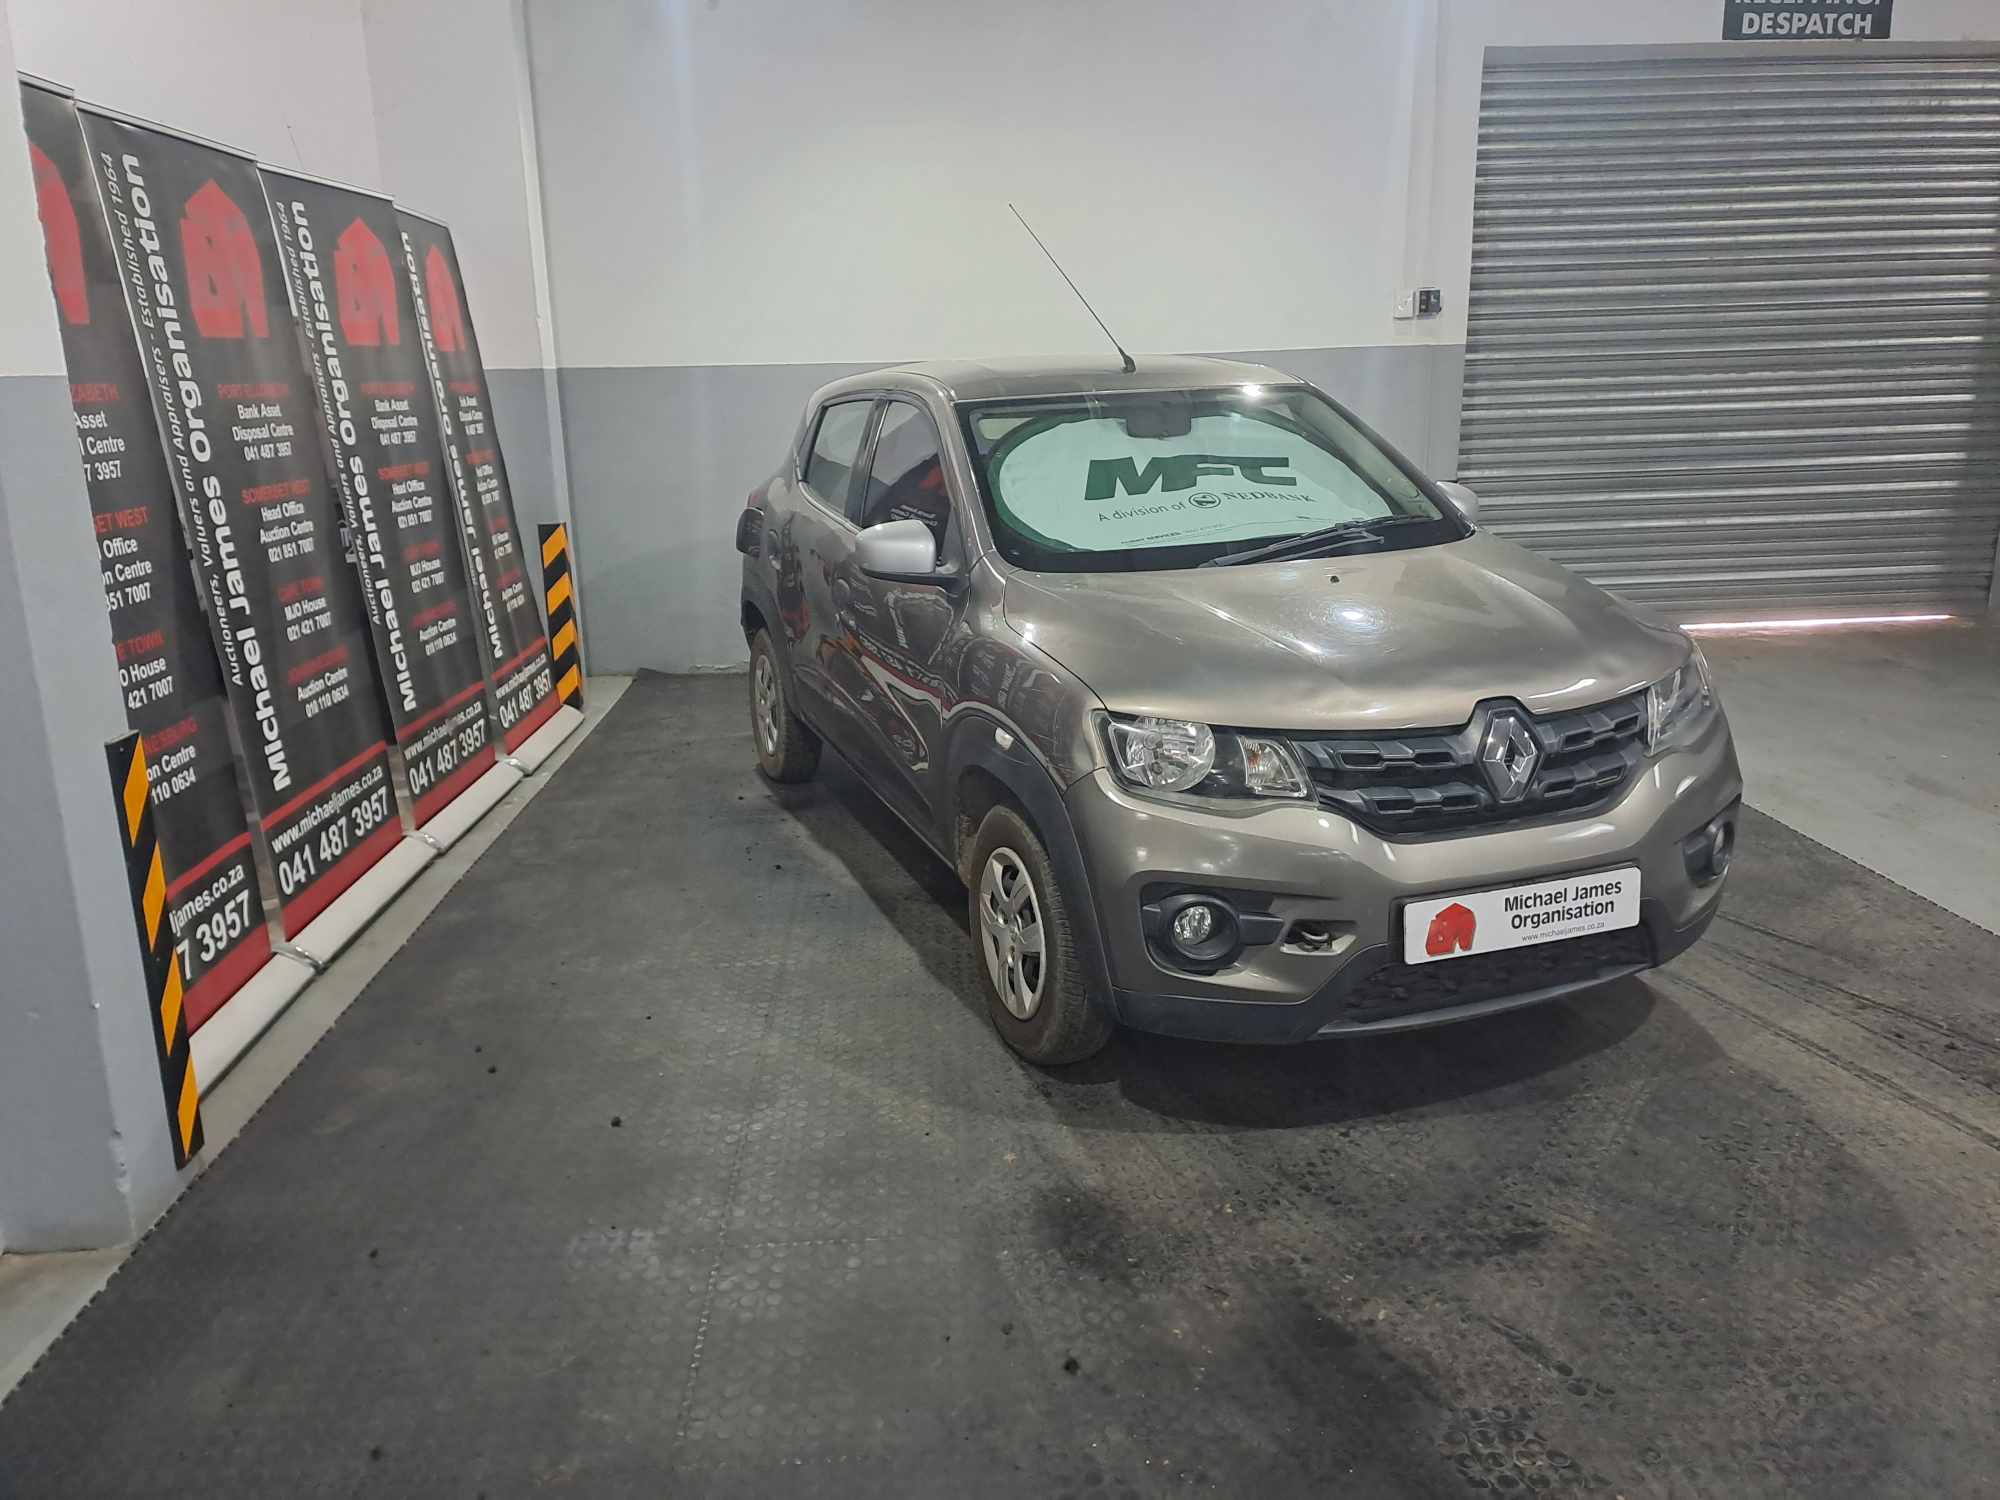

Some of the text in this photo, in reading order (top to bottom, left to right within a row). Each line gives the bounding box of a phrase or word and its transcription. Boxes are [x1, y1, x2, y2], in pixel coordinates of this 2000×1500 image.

[1742, 12, 1872, 34] DESPATCH
[101, 152, 123, 204] 1964
[114, 210, 154, 329] Established
[292, 202, 356, 446] Organisation
[152, 346, 186, 450] Appraisers
[237, 404, 260, 420] Bank
[86, 436, 126, 456] Centre
[232, 424, 270, 442] Disposal
[244, 445, 260, 461] 041
[260, 443, 276, 459] 487
[331, 438, 344, 468] and
[95, 460, 122, 481] 3957
[122, 154, 291, 792] Michael James Organisation
[176, 454, 195, 492] and
[1084, 454, 1297, 501] MFC
[350, 455, 386, 570] James
[1098, 490, 1317, 522] A division of NEDBANK
[189, 497, 213, 567] Valuers
[260, 525, 290, 544] Auction
[102, 537, 139, 559] Office
[268, 546, 283, 563] 021
[114, 559, 152, 584] Centre
[126, 582, 152, 606] 7007
[301, 597, 327, 614] House
[286, 624, 301, 642] 021
[374, 578, 416, 712] Michael
[130, 657, 167, 683] House
[128, 676, 174, 710] 421 7007
[297, 676, 326, 702] Auction
[500, 668, 552, 729] 041 487 3957
[162, 745, 196, 773] Centre
[409, 718, 486, 796] 041 487 3957
[172, 767, 196, 795] 0634
[272, 766, 383, 854] www.michaeljames.co.za
[279, 786, 388, 896] 041 487 3957
[1504, 881, 1622, 912] Michael James
[196, 890, 250, 962] 3957
[1511, 900, 1615, 929] Organisation
[1522, 922, 1605, 942] www.michaeljames.co.za
